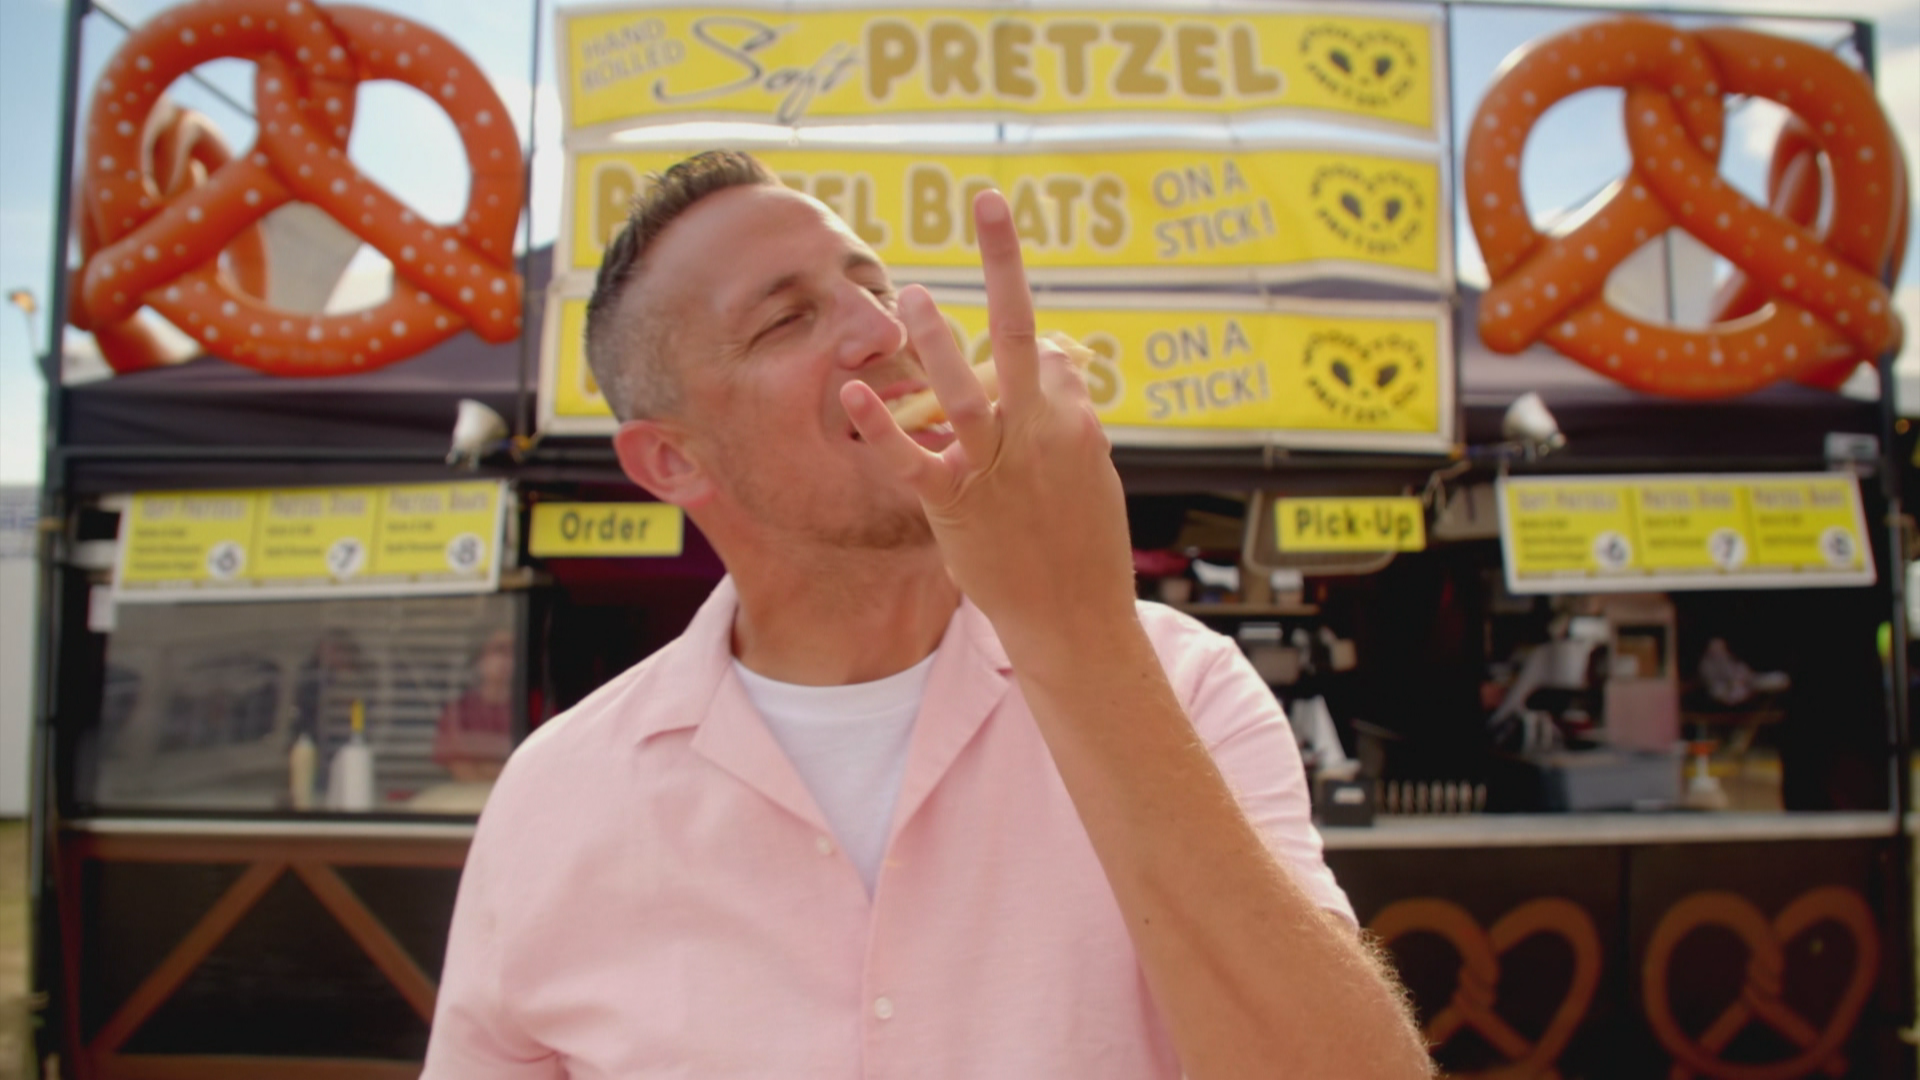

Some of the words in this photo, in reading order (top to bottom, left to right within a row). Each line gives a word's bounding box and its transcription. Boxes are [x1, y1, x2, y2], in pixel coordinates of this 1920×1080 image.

[581, 38, 686, 92] ROLLED
[582, 19, 667, 62] HAND
[653, 15, 864, 125] Soft
[865, 19, 1286, 101] PRETZEL
[1150, 163, 1216, 209] ON
[1222, 158, 1252, 196] A
[1153, 196, 1277, 260] STICK!
[1144, 324, 1210, 370] ON
[1221, 319, 1253, 359] A
[1144, 359, 1272, 421] STICK!
[560, 510, 650, 542] Order
[1296, 505, 1413, 542] Pick-Up
